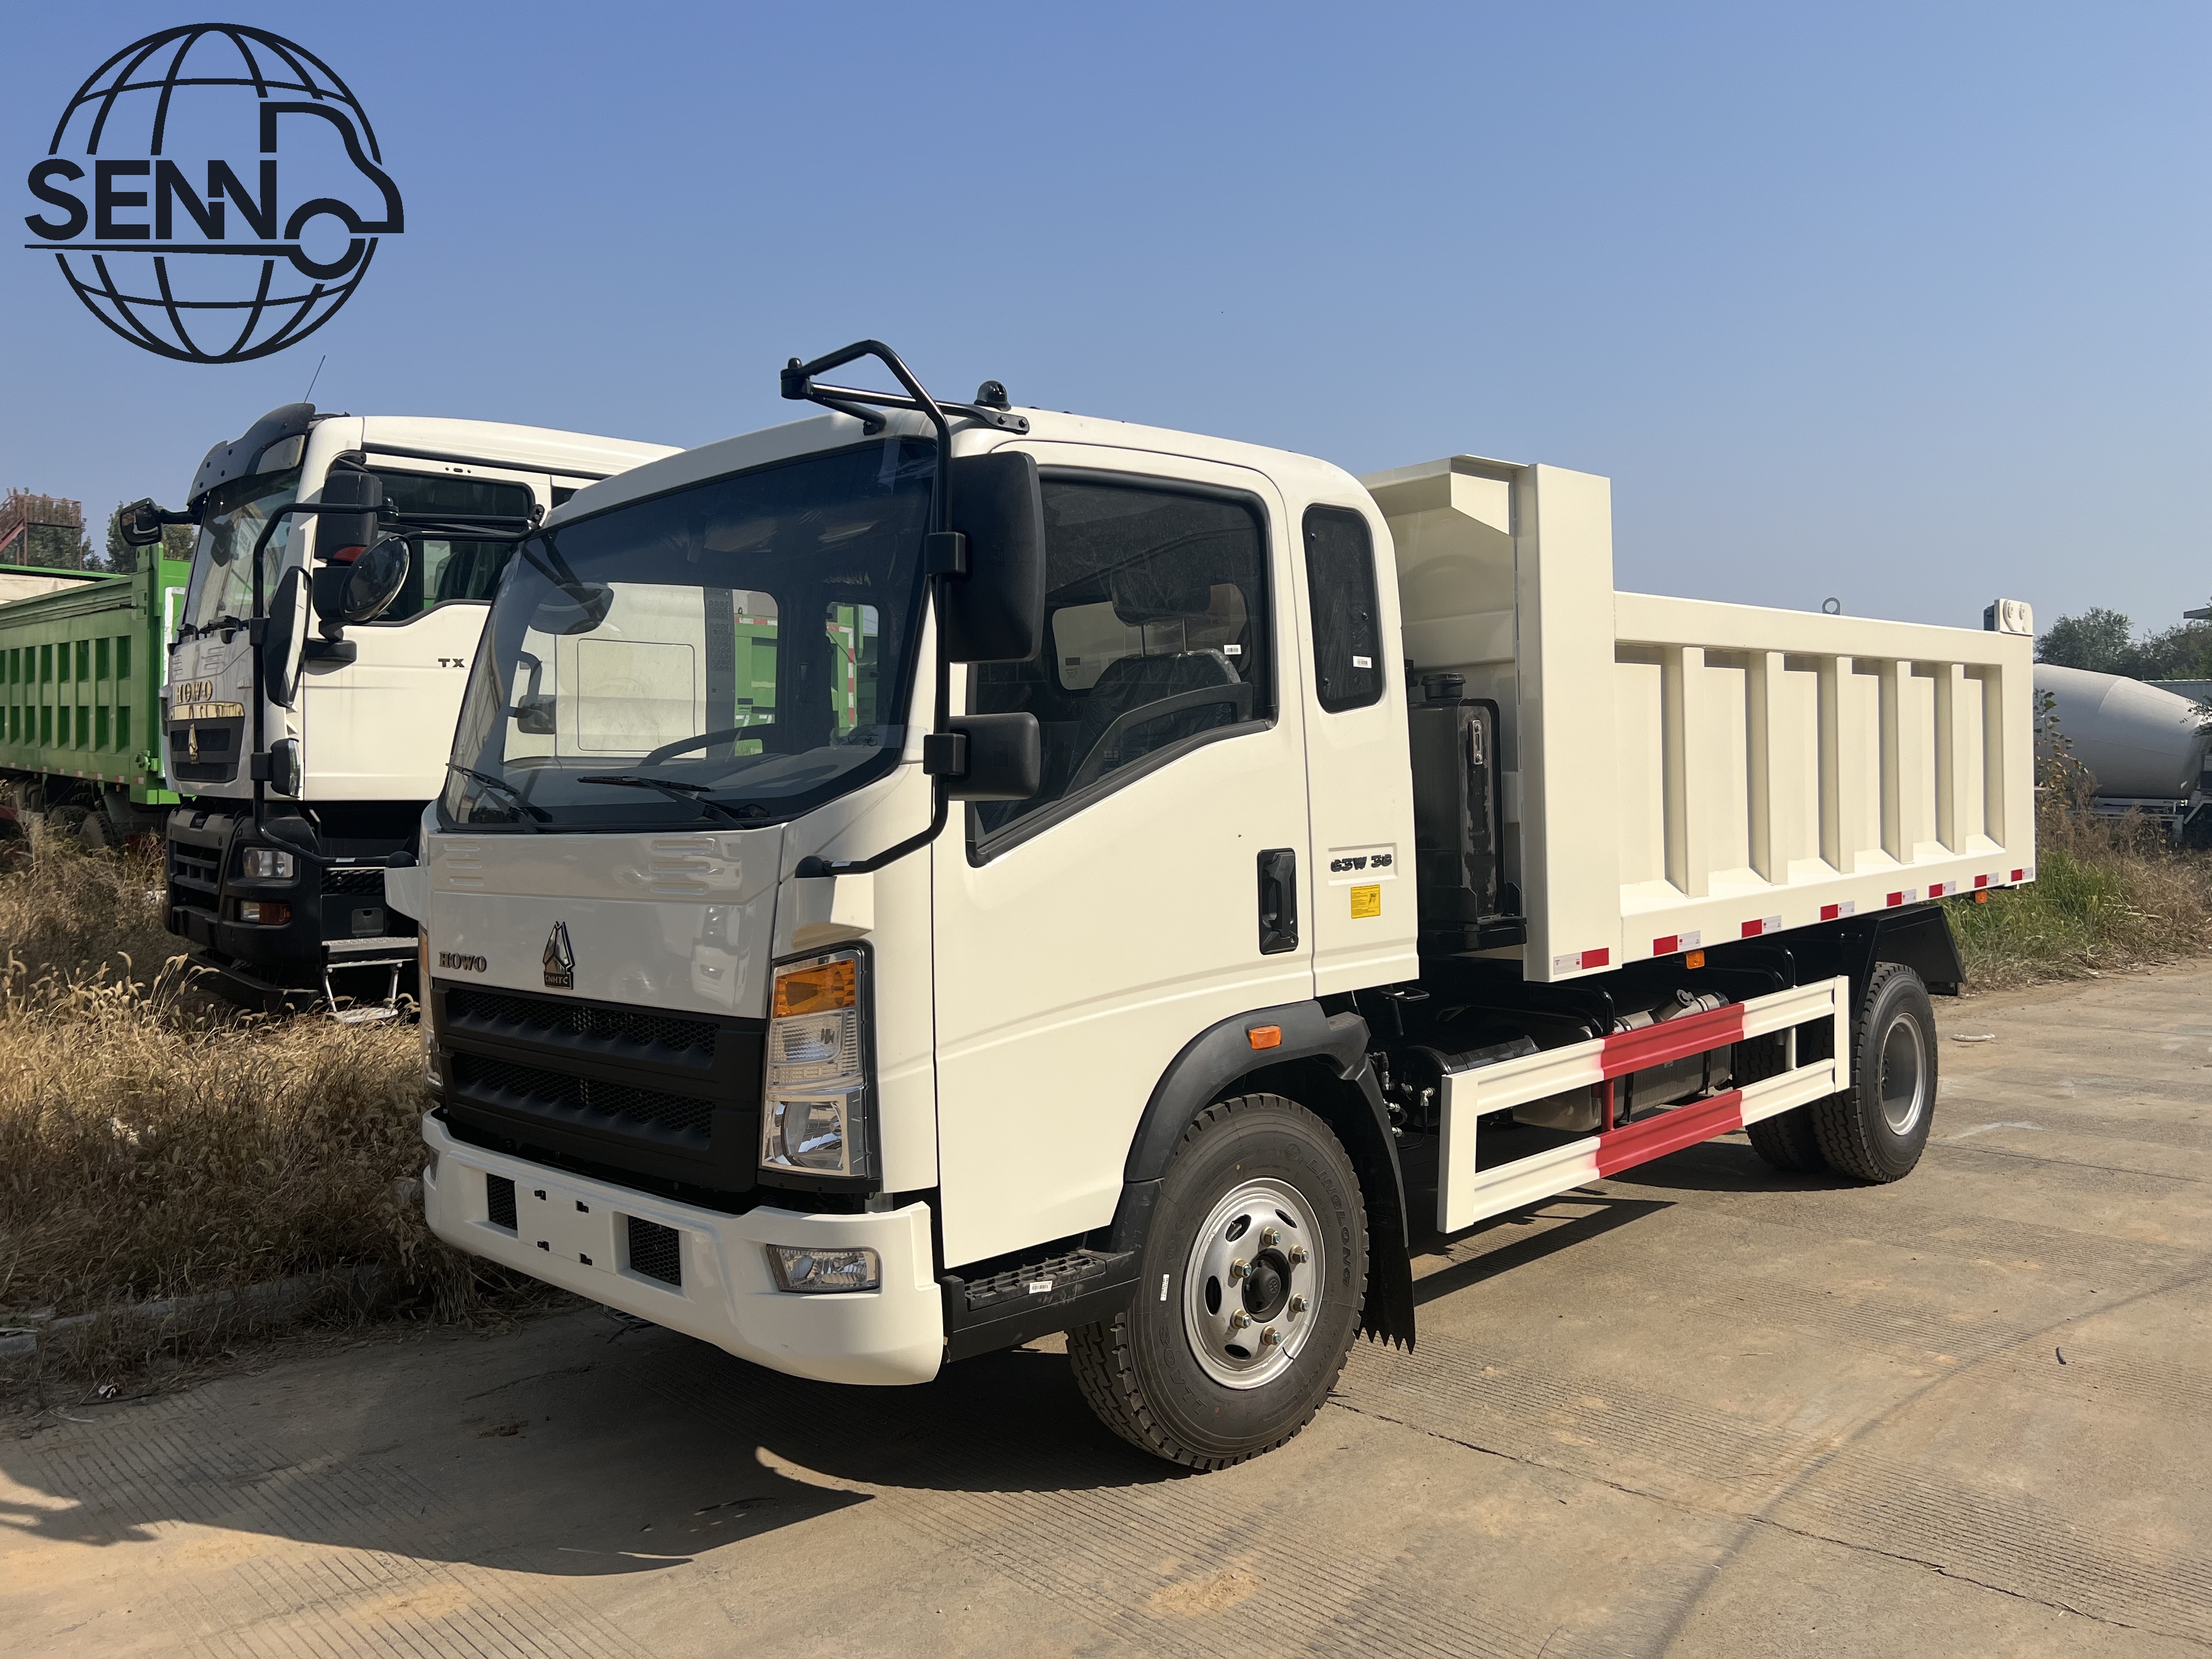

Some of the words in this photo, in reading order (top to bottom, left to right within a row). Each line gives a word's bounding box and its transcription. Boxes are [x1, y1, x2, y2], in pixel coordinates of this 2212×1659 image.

[438, 658, 465, 668] TX
[176, 679, 213, 704] HOWO
[439, 951, 487, 973] HOWO
[545, 975, 568, 985] CNHTC
[1306, 1158, 1351, 1288] LINGLONG
